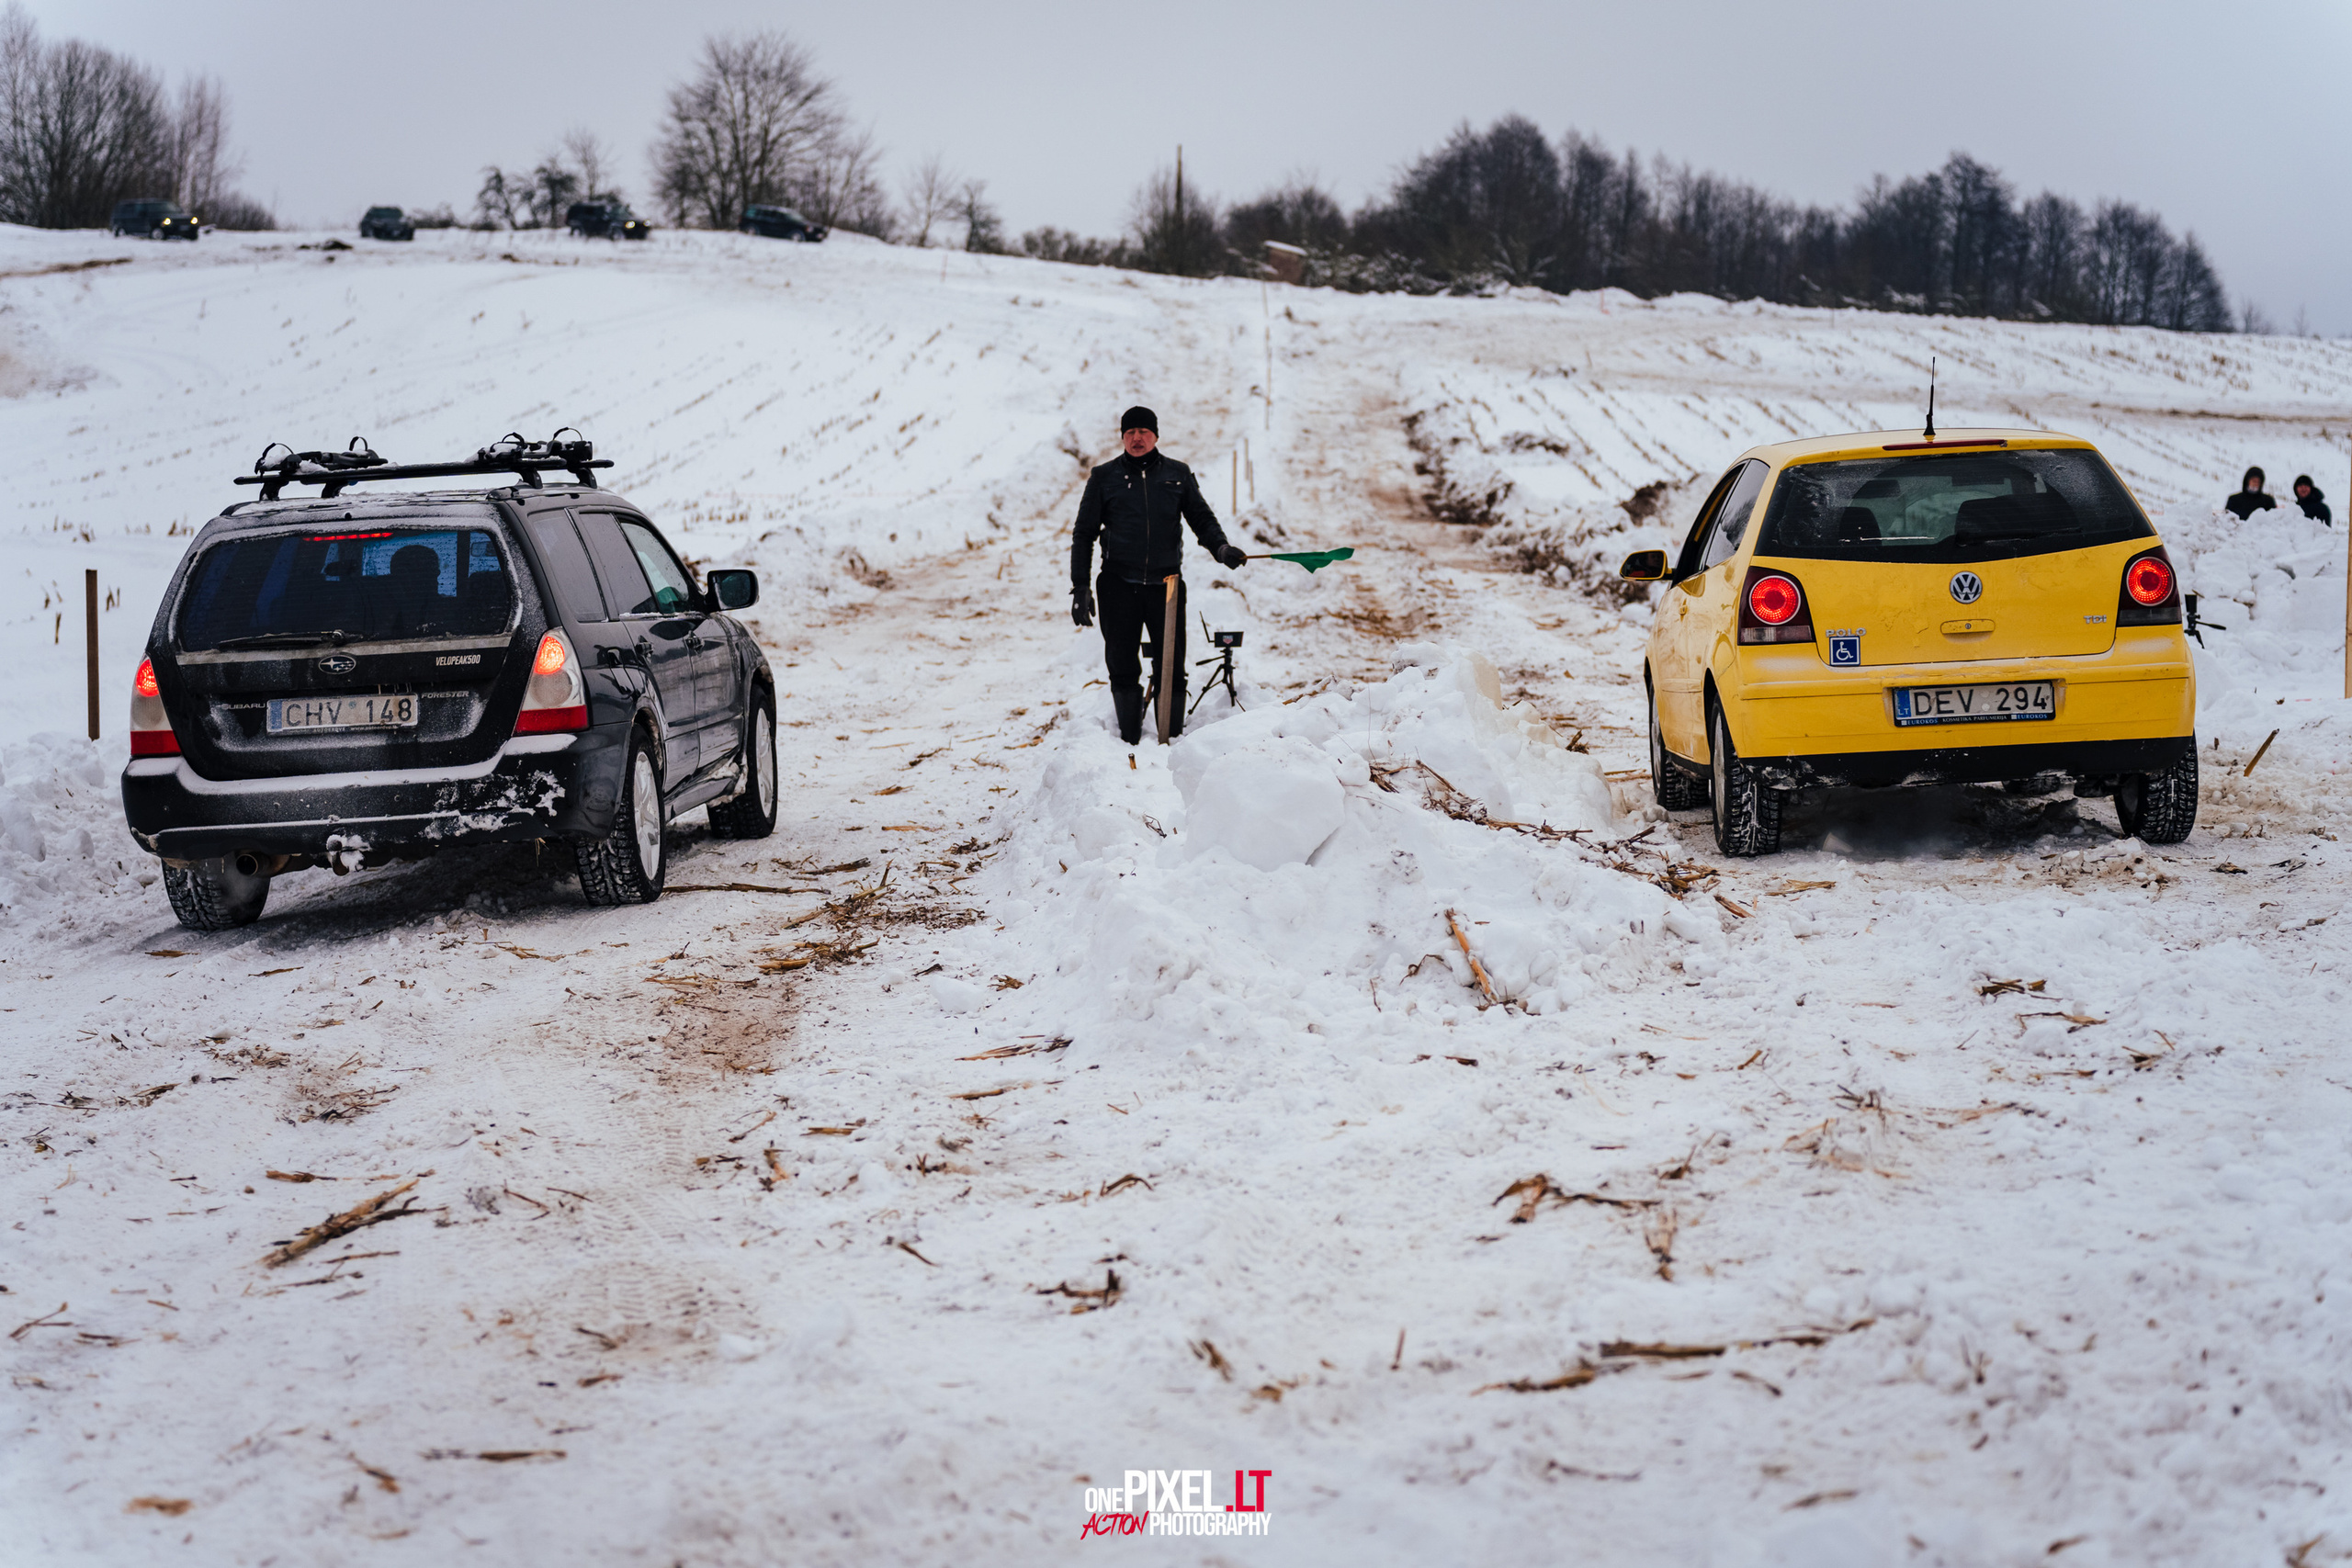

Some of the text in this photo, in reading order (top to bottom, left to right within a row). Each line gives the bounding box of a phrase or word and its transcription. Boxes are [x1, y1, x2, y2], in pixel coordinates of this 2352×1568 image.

[2083, 614, 2107, 625] TDI
[1825, 626, 1867, 637] POLO
[435, 654, 481, 666] VELOPEAK500
[421, 690, 469, 699] FORESTER
[1913, 686, 2048, 716] DEV 294
[286, 698, 413, 727] CHV 148
[1898, 707, 1910, 716] LT
[1907, 717, 1939, 726] EUROKOS
